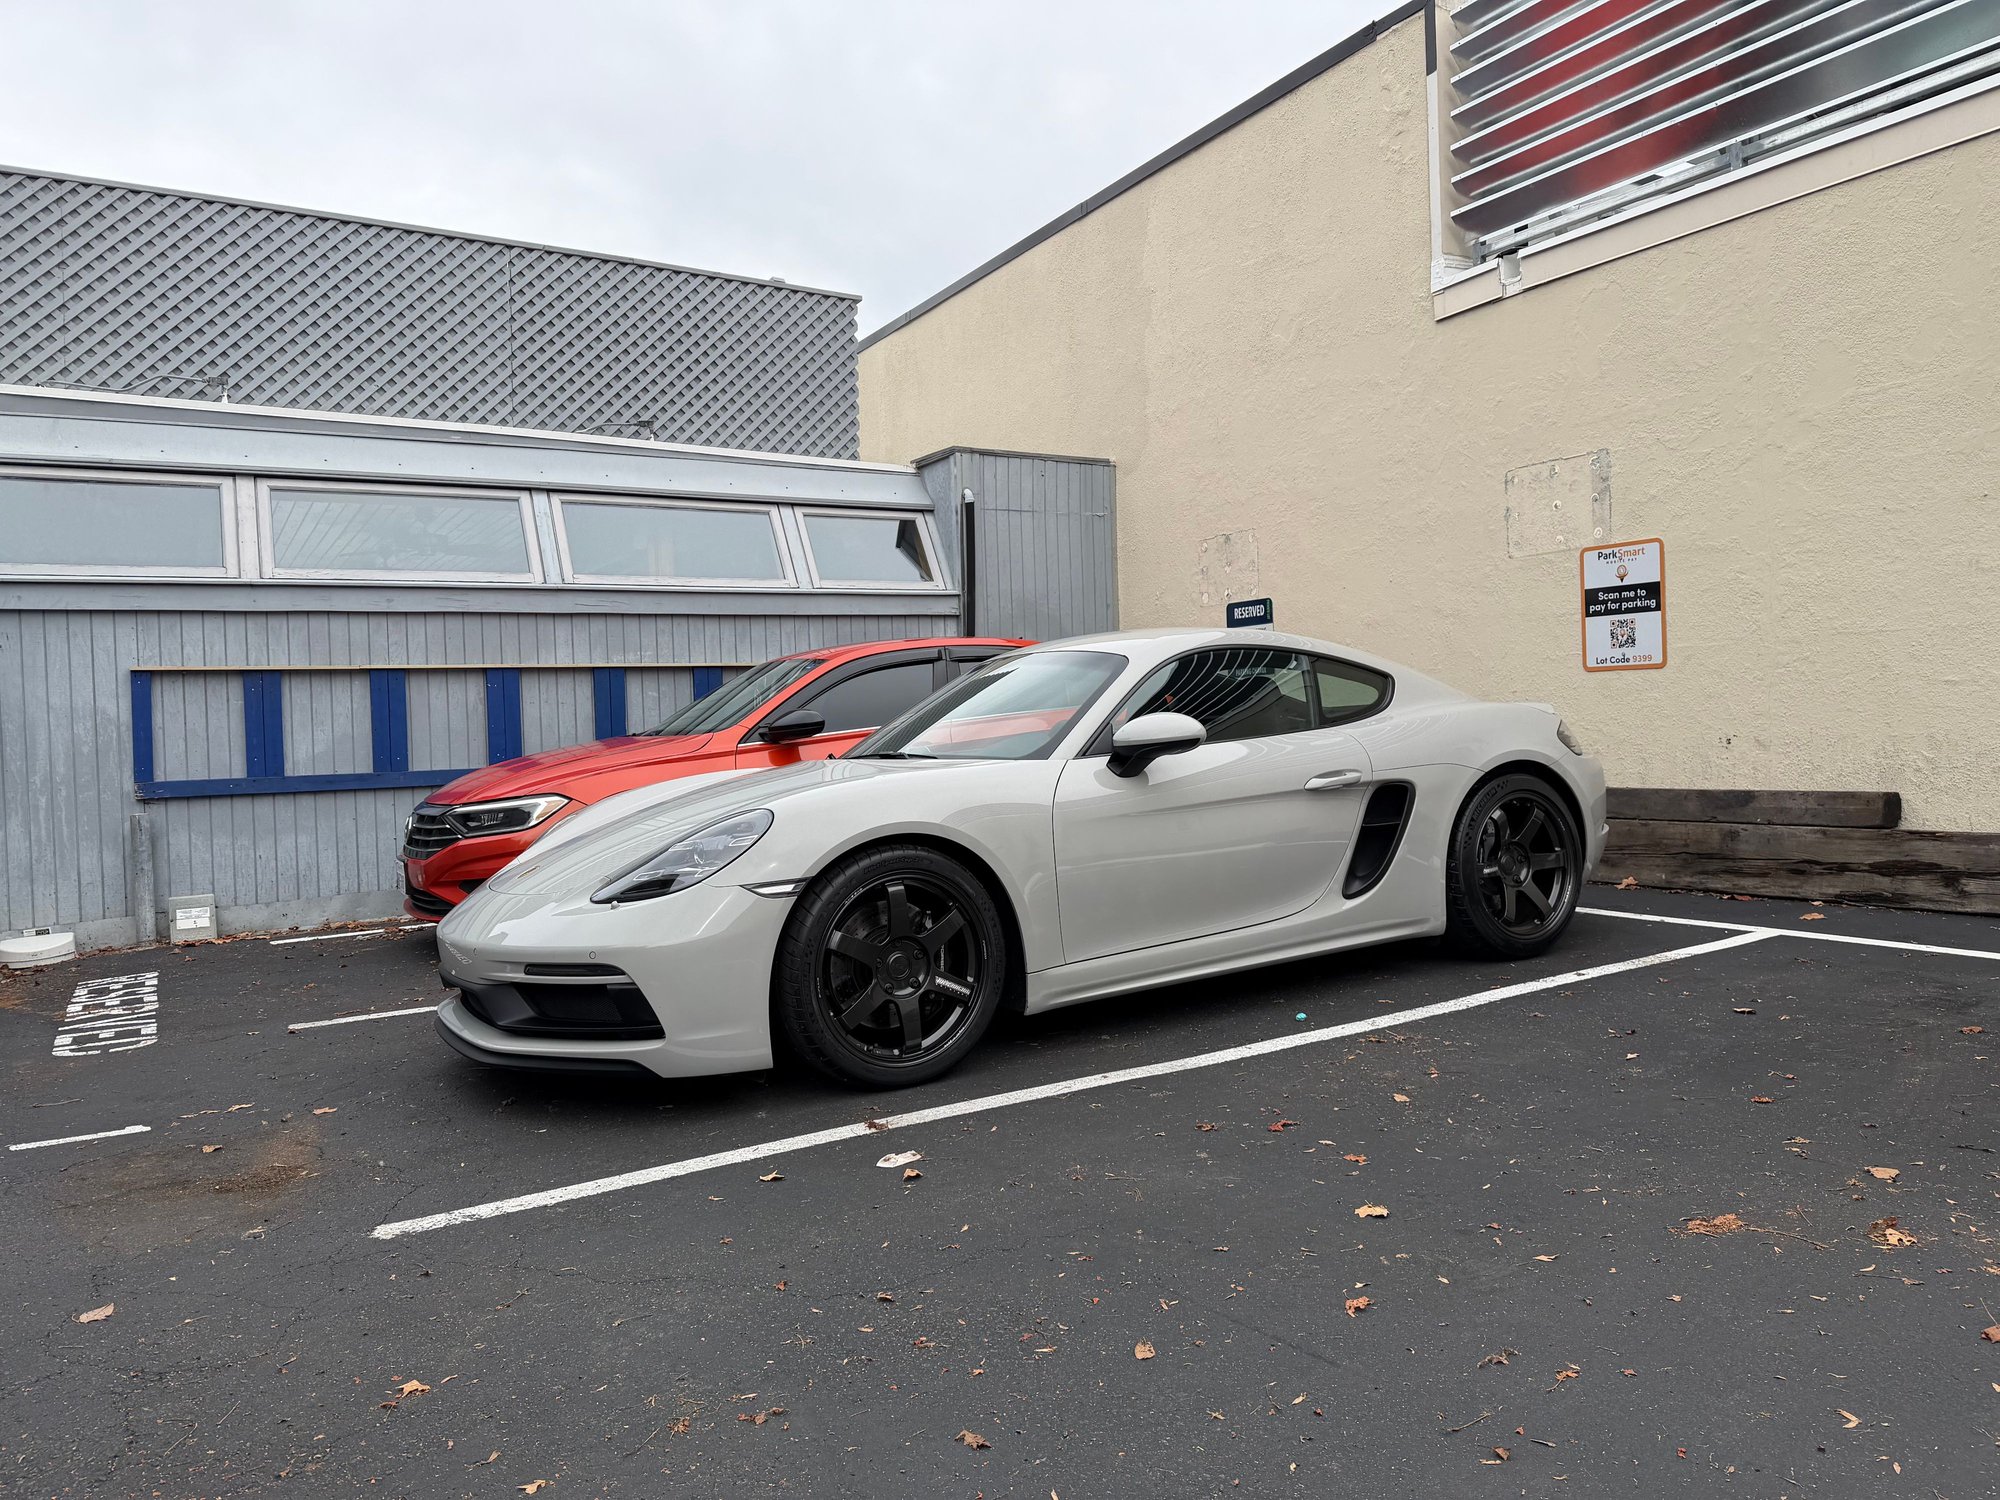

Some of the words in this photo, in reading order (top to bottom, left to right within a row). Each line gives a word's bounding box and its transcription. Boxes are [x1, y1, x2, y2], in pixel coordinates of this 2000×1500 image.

[1597, 547, 1645, 560] ParkSmart
[1598, 591, 1620, 601] Scan
[1621, 590, 1636, 598] me
[1637, 588, 1647, 597] to
[1234, 604, 1265, 619] RESERVED
[1589, 603, 1606, 614] pay
[1607, 601, 1621, 611] for
[1621, 598, 1657, 611] parking
[1596, 656, 1608, 664] Lot
[1609, 654, 1631, 664] Code
[1632, 654, 1653, 663] 9399
[51, 971, 159, 1056] RESERVED
